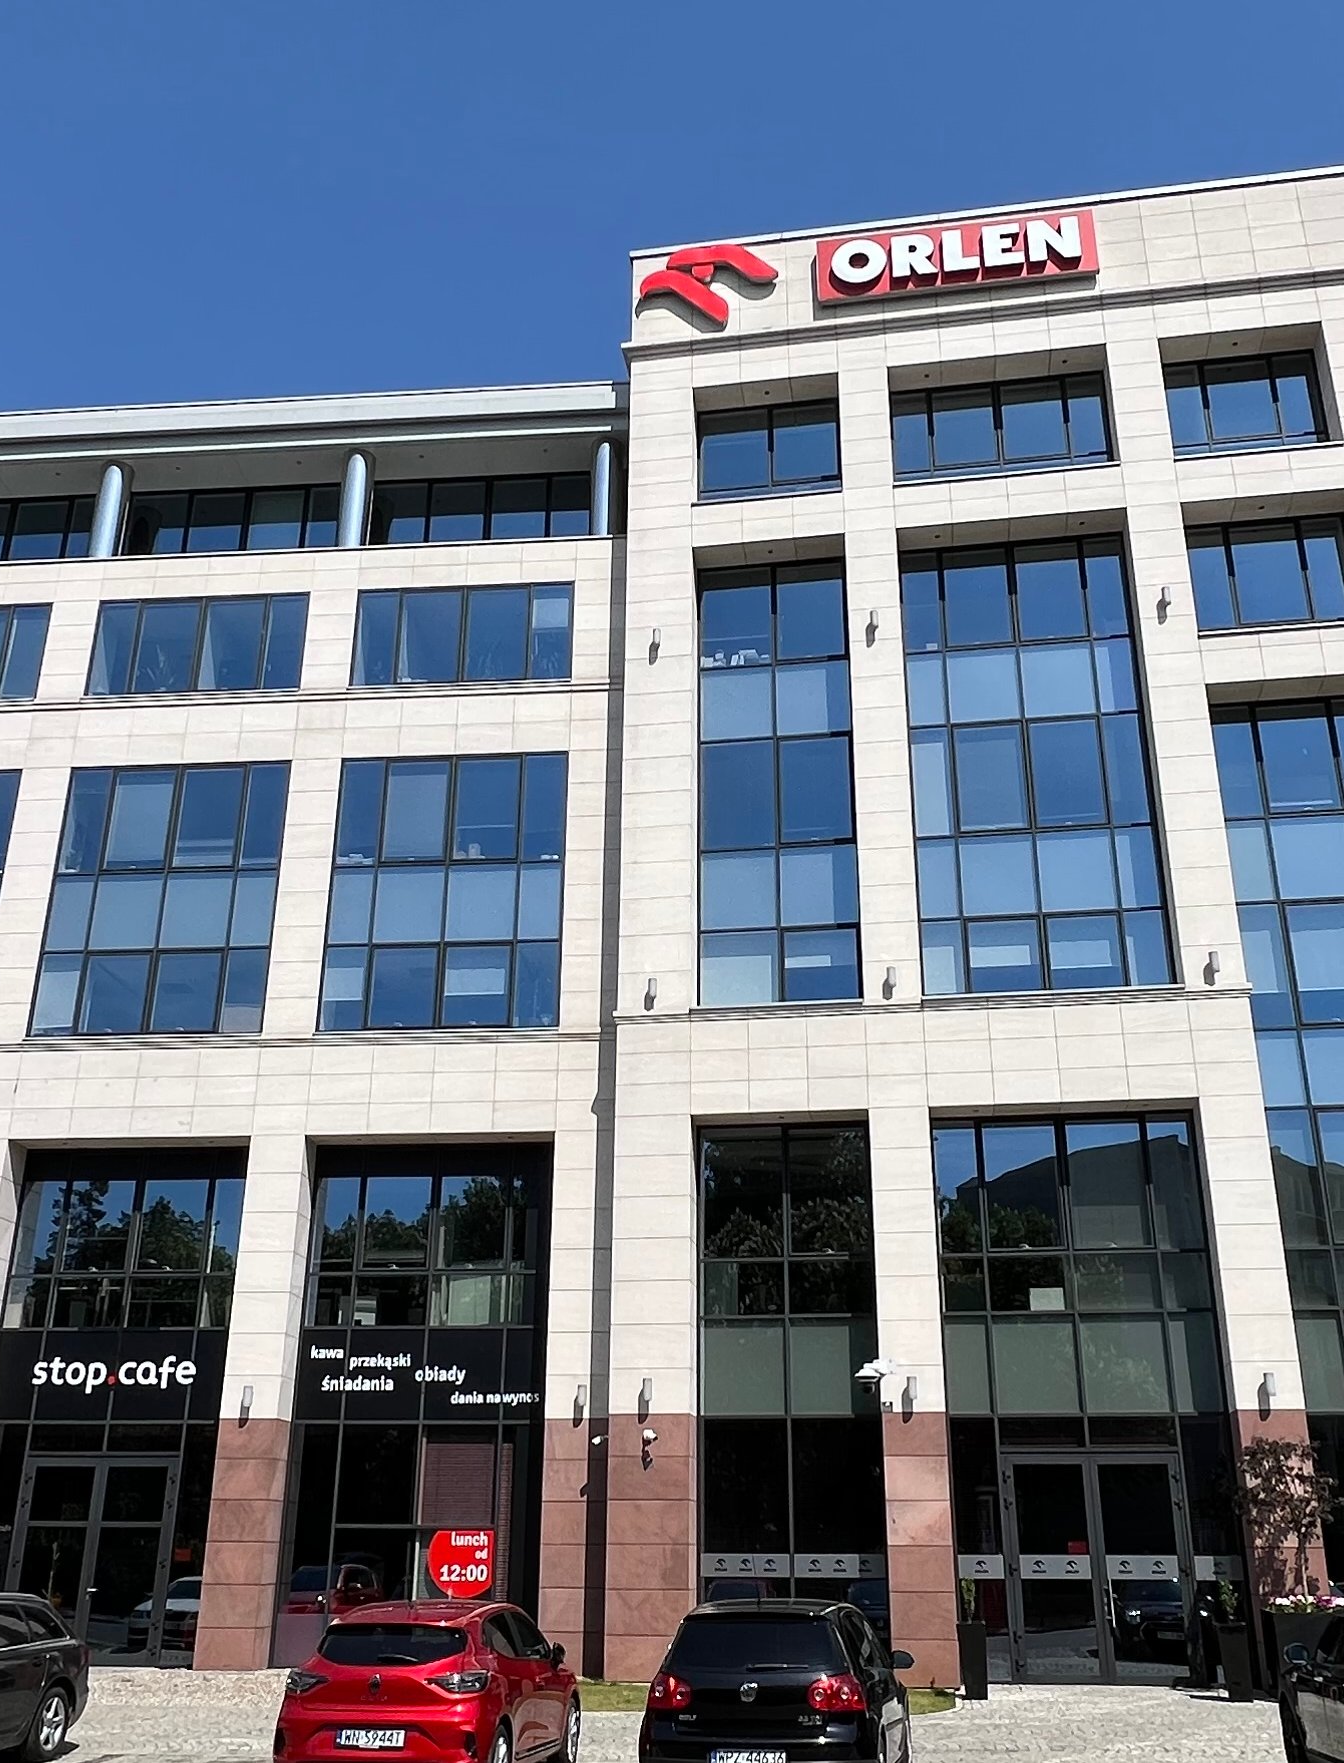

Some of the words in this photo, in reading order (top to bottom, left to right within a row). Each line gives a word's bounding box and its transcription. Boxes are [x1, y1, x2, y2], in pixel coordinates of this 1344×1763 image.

[830, 216, 1082, 285] ORLEN
[310, 1345, 344, 1359] kawa
[349, 1353, 412, 1371] przekąski
[32, 1355, 197, 1393] stop.cafe
[321, 1374, 394, 1392] śniadania
[414, 1365, 467, 1385] obiady
[451, 1391, 484, 1404] dania
[451, 1531, 489, 1546] lunch
[474, 1547, 489, 1560] od
[439, 1564, 488, 1582] 12:00
[364, 1730, 401, 1746] 5944T
